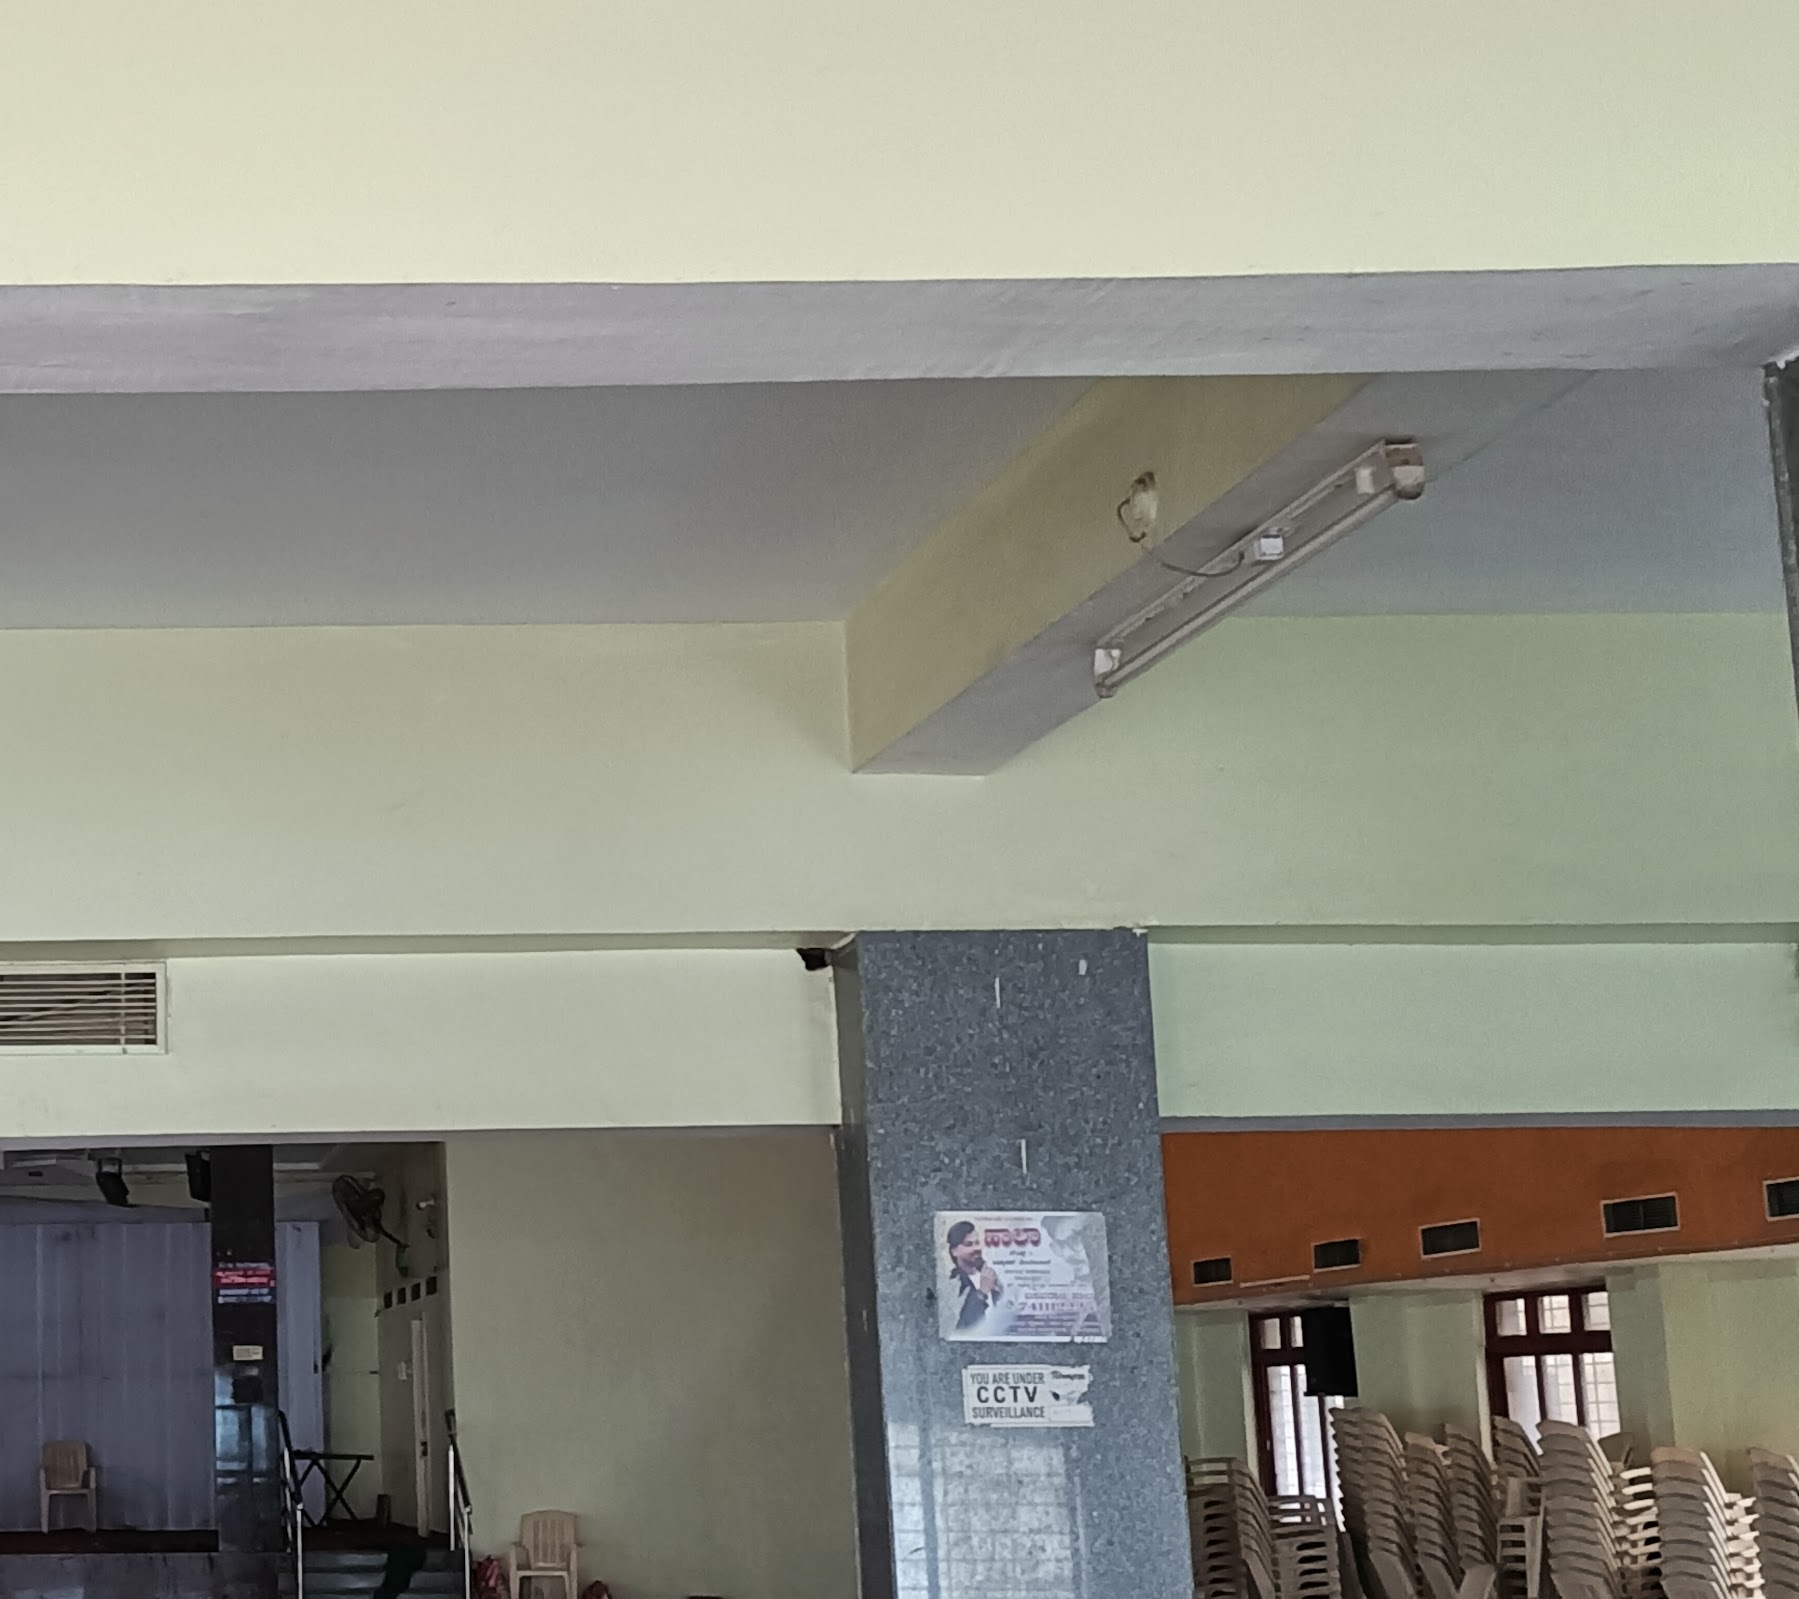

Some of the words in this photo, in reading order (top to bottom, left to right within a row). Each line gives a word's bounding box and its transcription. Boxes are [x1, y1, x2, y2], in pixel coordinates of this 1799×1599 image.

[969, 1372, 990, 1385] YOU
[991, 1372, 1010, 1385] ARE
[1012, 1372, 1046, 1385] UNDER
[976, 1385, 1038, 1404] CCTV
[972, 1406, 1046, 1419] SURVEILLANCE
